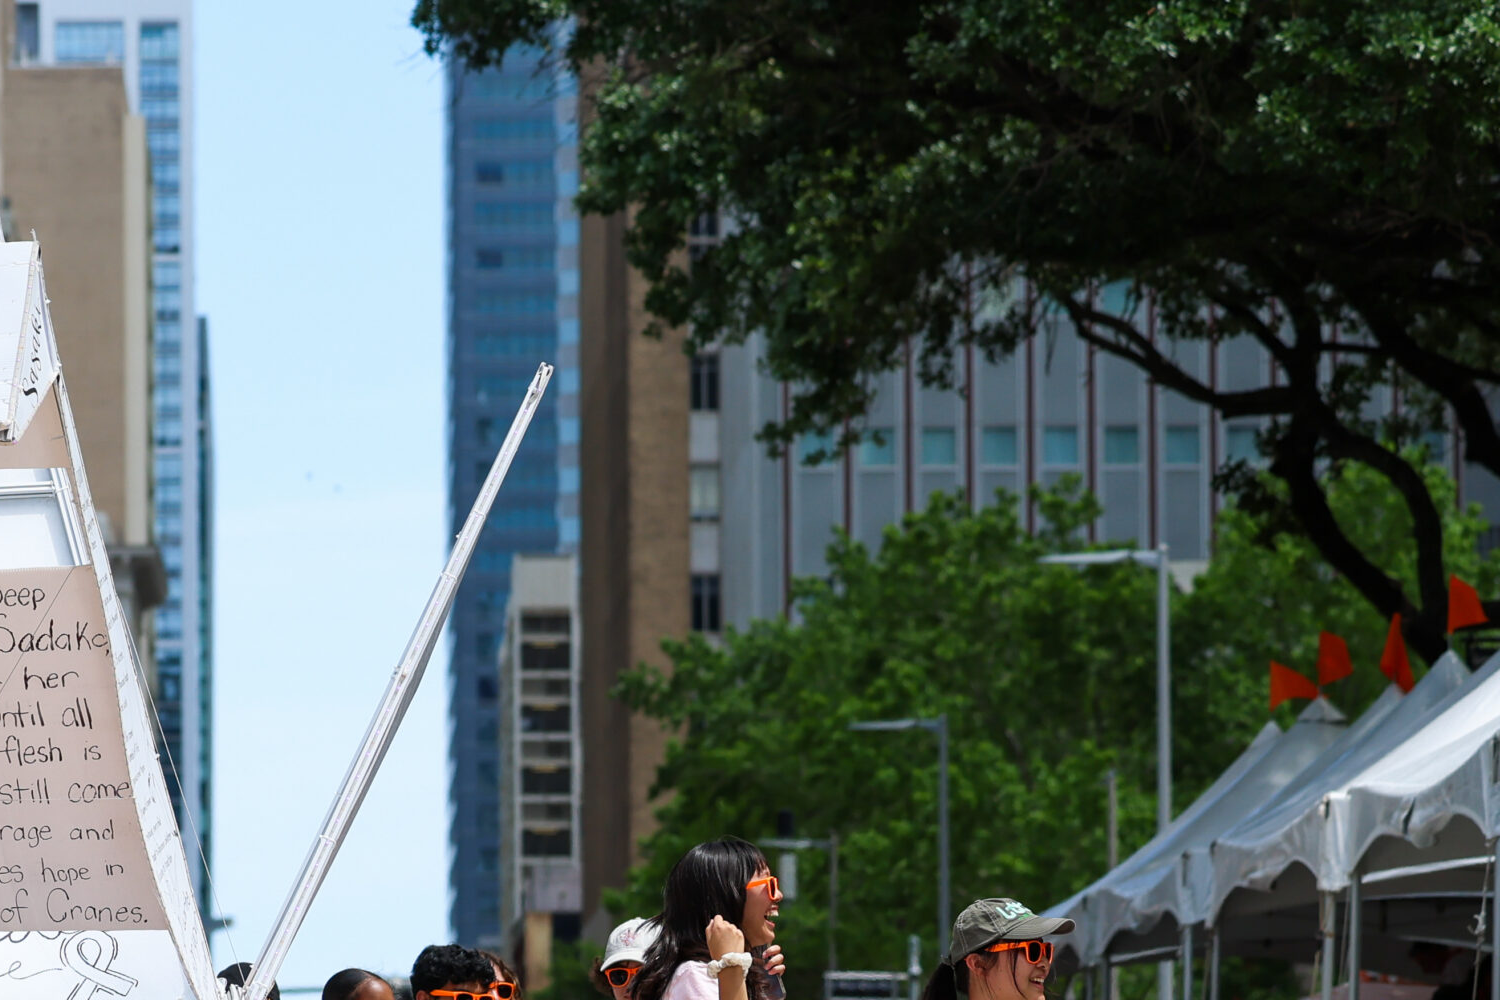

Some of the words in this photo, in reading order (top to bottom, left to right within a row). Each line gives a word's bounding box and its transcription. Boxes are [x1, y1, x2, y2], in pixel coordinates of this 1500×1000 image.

[22, 304, 42, 408] Sasaki
[23, 667, 80, 691] her
[61, 698, 93, 729] all
[84, 741, 102, 761] is
[0, 824, 53, 848] rage
[70, 819, 115, 842] and
[41, 857, 91, 886] hope
[105, 861, 125, 876] in
[0, 888, 28, 924] of
[46, 887, 149, 924] Cranes.
